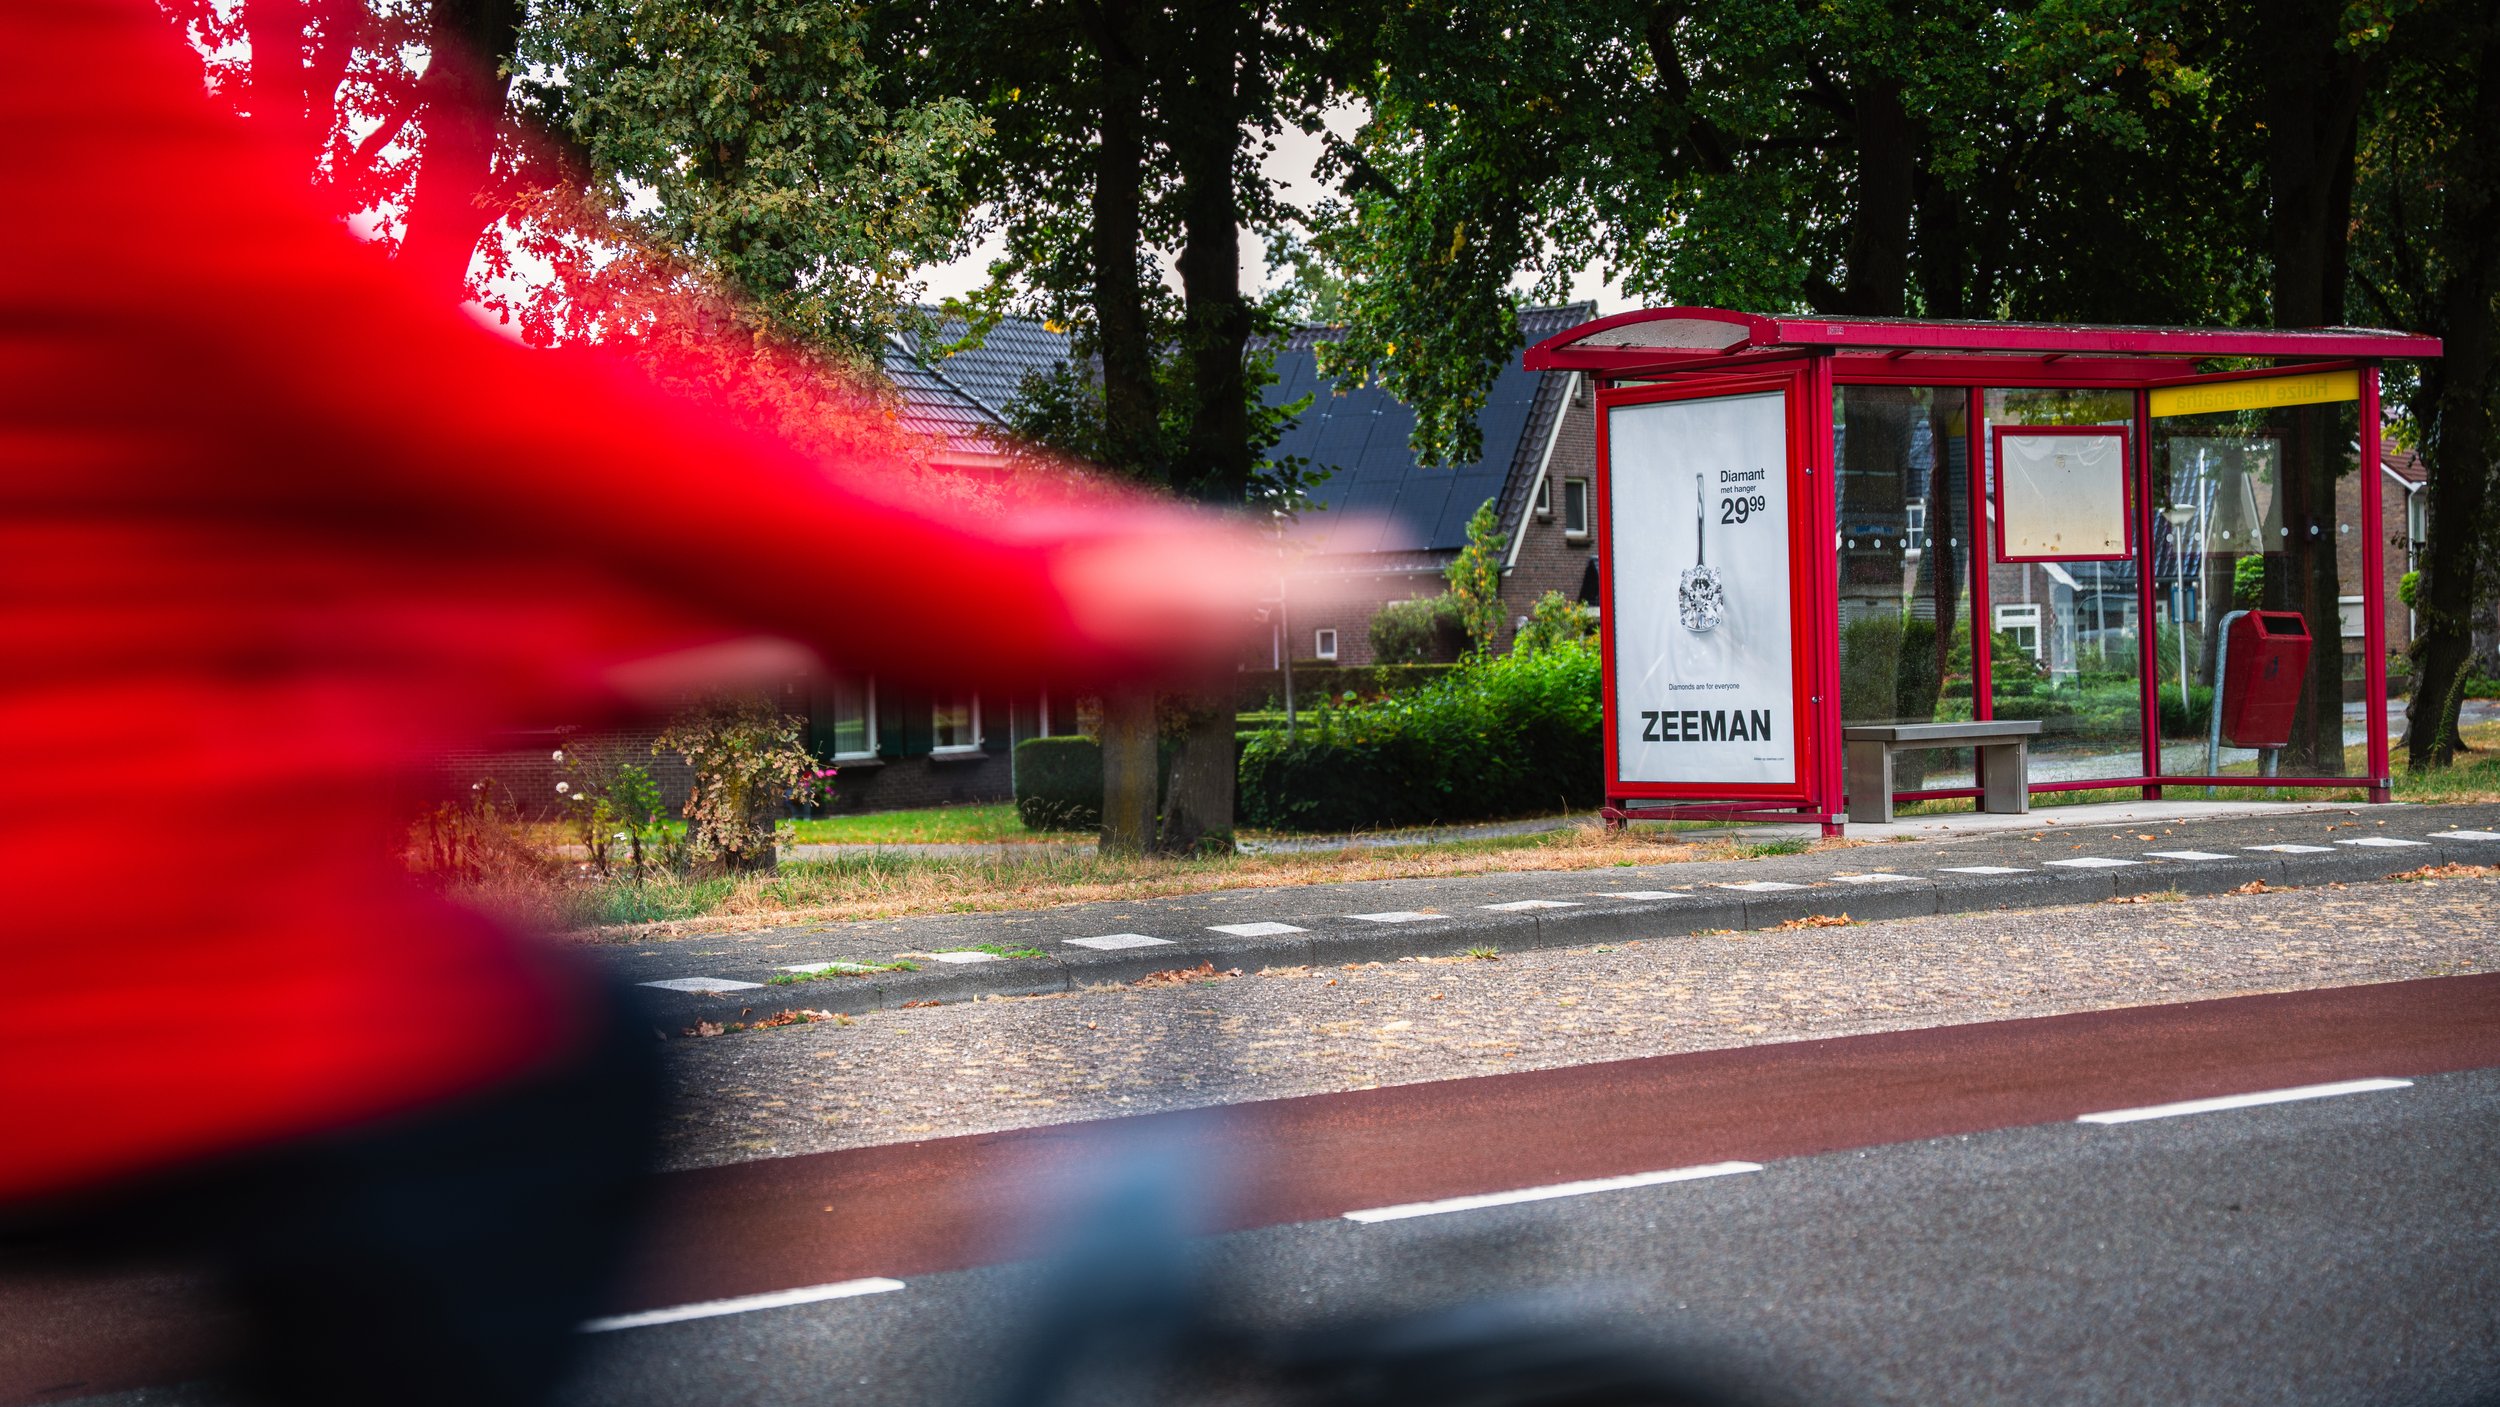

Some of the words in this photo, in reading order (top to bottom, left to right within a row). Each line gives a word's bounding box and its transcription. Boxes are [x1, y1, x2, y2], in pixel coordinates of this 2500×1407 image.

[1720, 467, 1765, 483] Diamant
[1720, 486, 1733, 494] met
[1734, 485, 1757, 494] hanger
[1668, 683, 1695, 691] Diamonds
[1714, 683, 1740, 691] everyone
[1641, 709, 1771, 742] ZEEMAN
